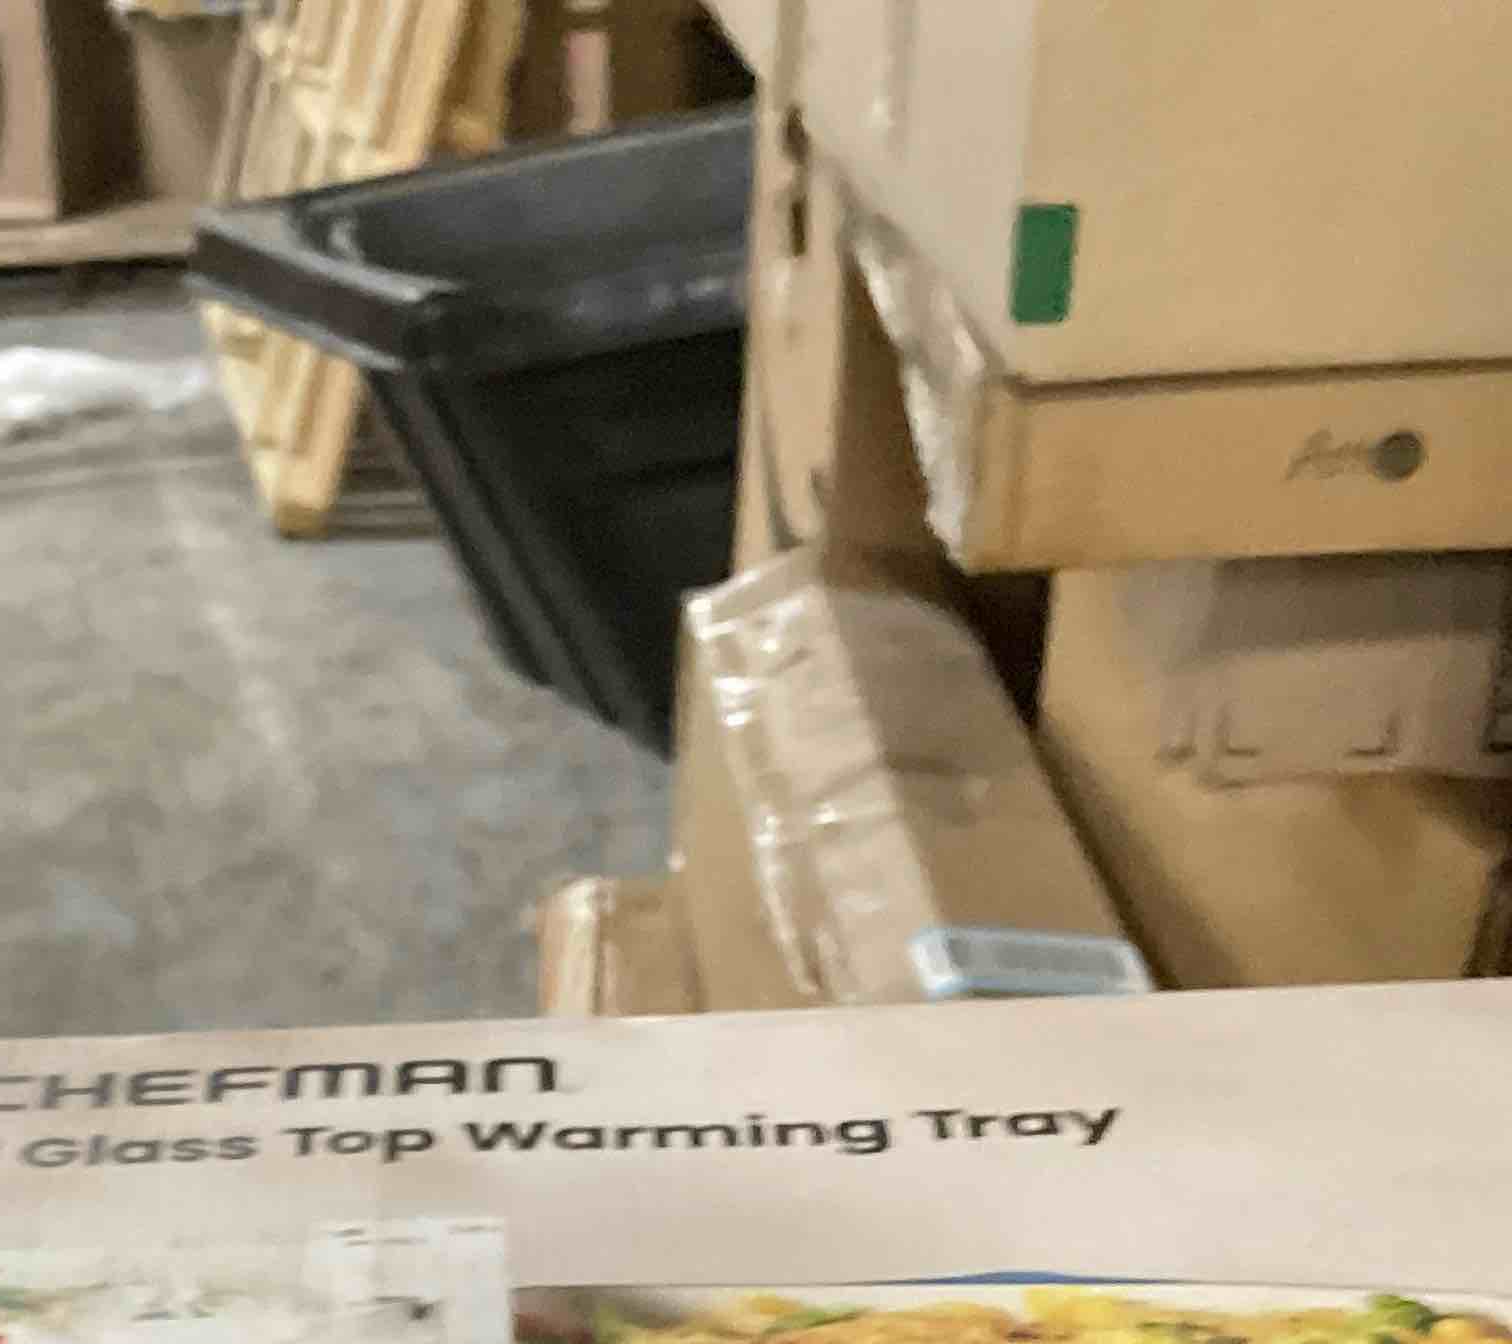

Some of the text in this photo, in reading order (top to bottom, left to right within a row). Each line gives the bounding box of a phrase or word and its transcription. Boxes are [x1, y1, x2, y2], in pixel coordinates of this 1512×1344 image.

[22, 1133, 257, 1169] Glass
[283, 1122, 437, 1164] Top
[464, 1113, 890, 1156] Warming
[913, 1106, 1122, 1146] Tray
